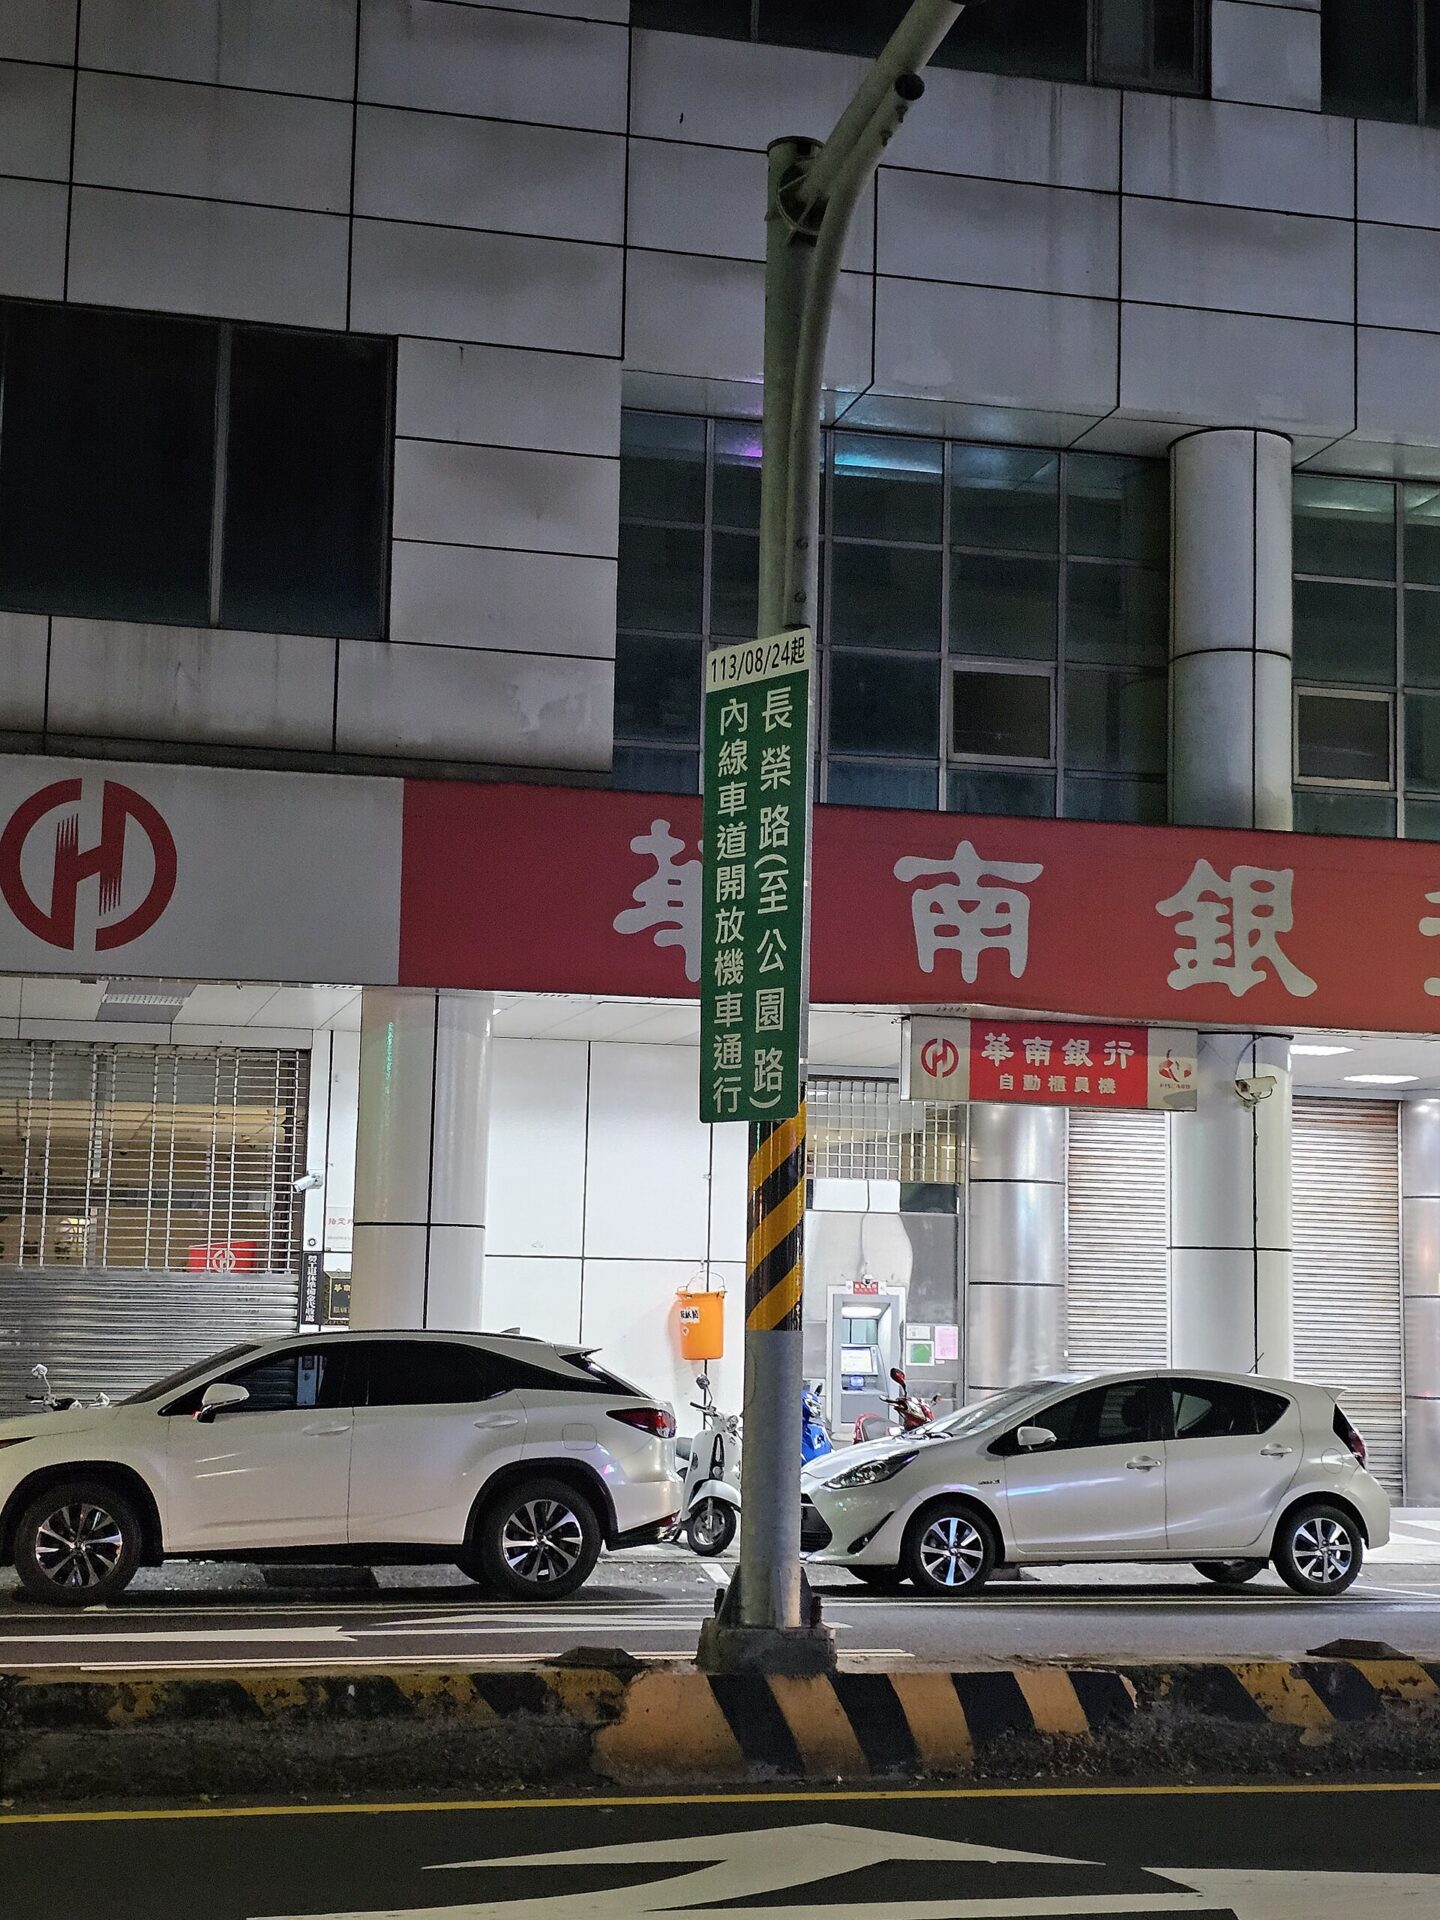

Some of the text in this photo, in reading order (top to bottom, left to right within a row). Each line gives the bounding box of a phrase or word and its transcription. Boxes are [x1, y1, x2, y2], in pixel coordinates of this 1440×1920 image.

[711, 636, 805, 682] 113/08/24起
[613, 819, 1440, 997] 華南銀
[713, 698, 749, 1113] 內線車道開放機車通行
[750, 686, 793, 1109] 長榮路(至公園路)
[981, 1032, 1135, 1069] 華南銀行
[1000, 1073, 1116, 1094] 自動櫃員機
